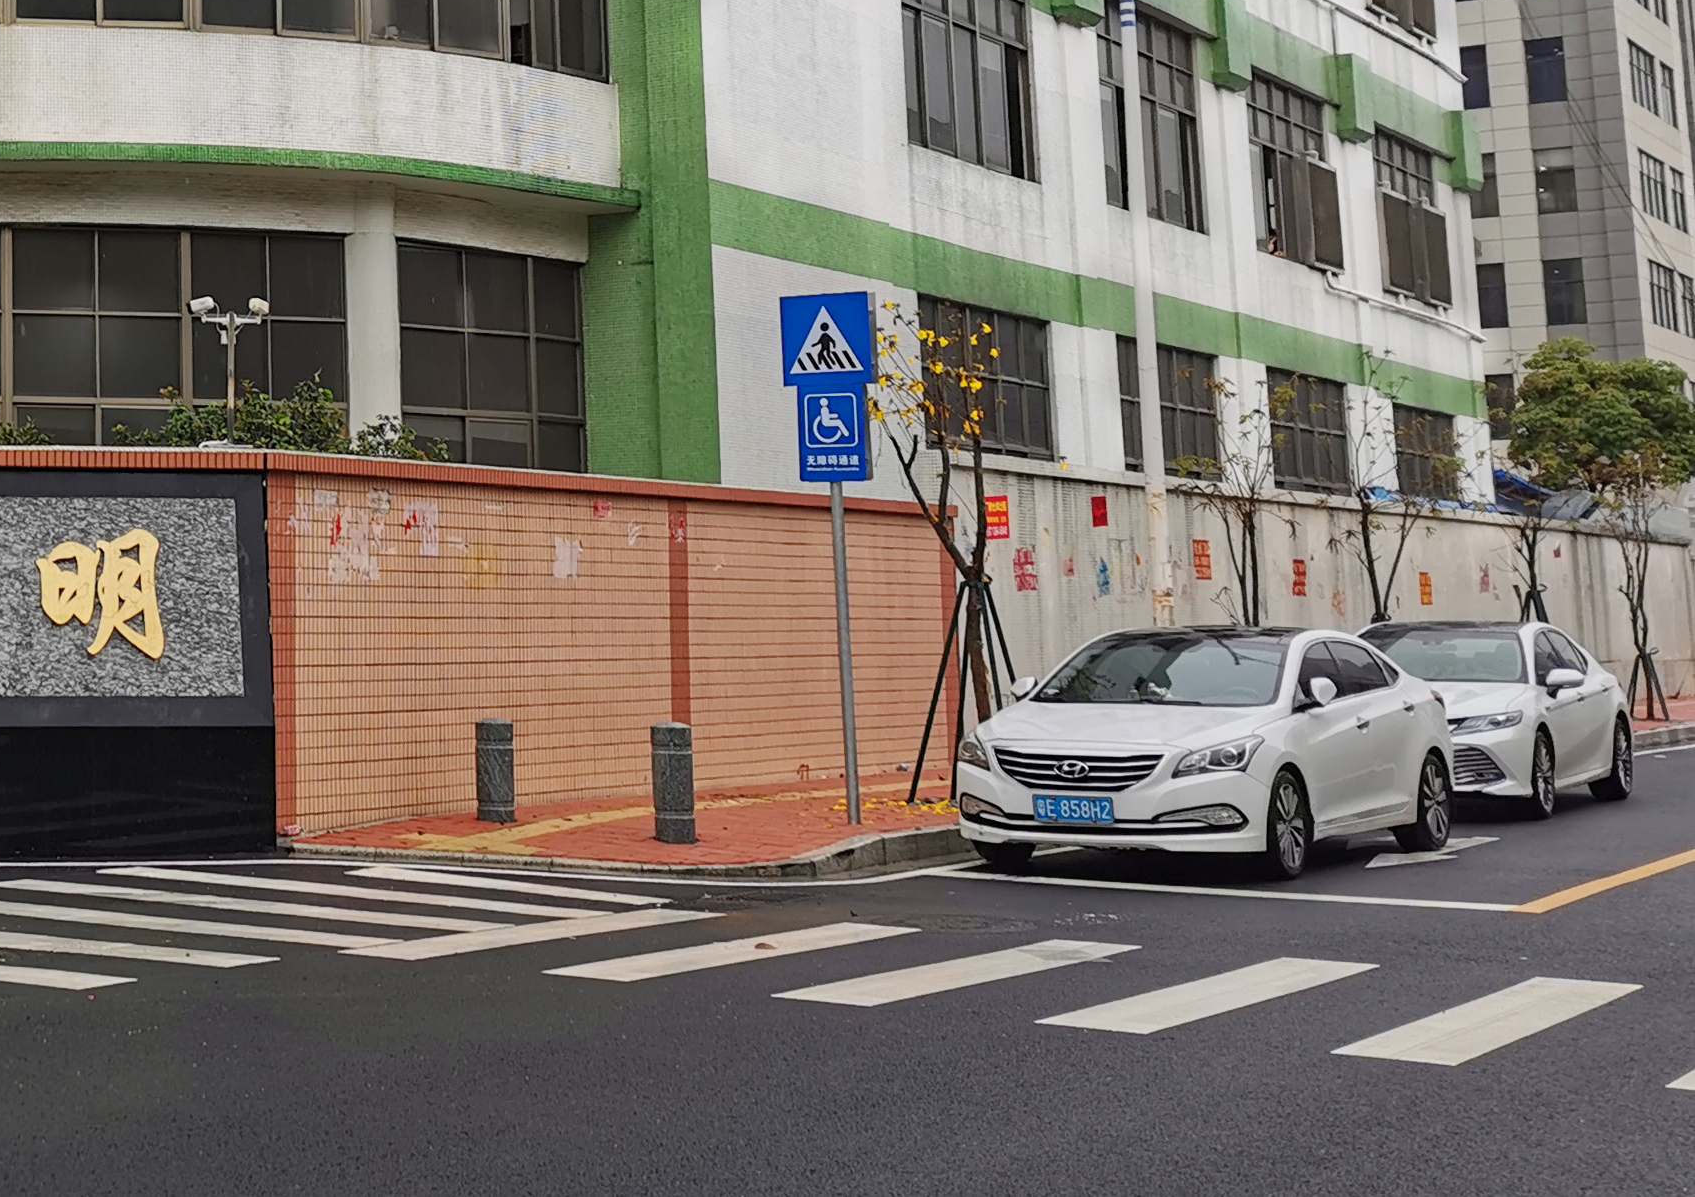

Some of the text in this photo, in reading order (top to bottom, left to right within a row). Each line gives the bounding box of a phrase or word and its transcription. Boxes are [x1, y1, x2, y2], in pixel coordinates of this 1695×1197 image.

[806, 454, 860, 466] 无障碍通道
